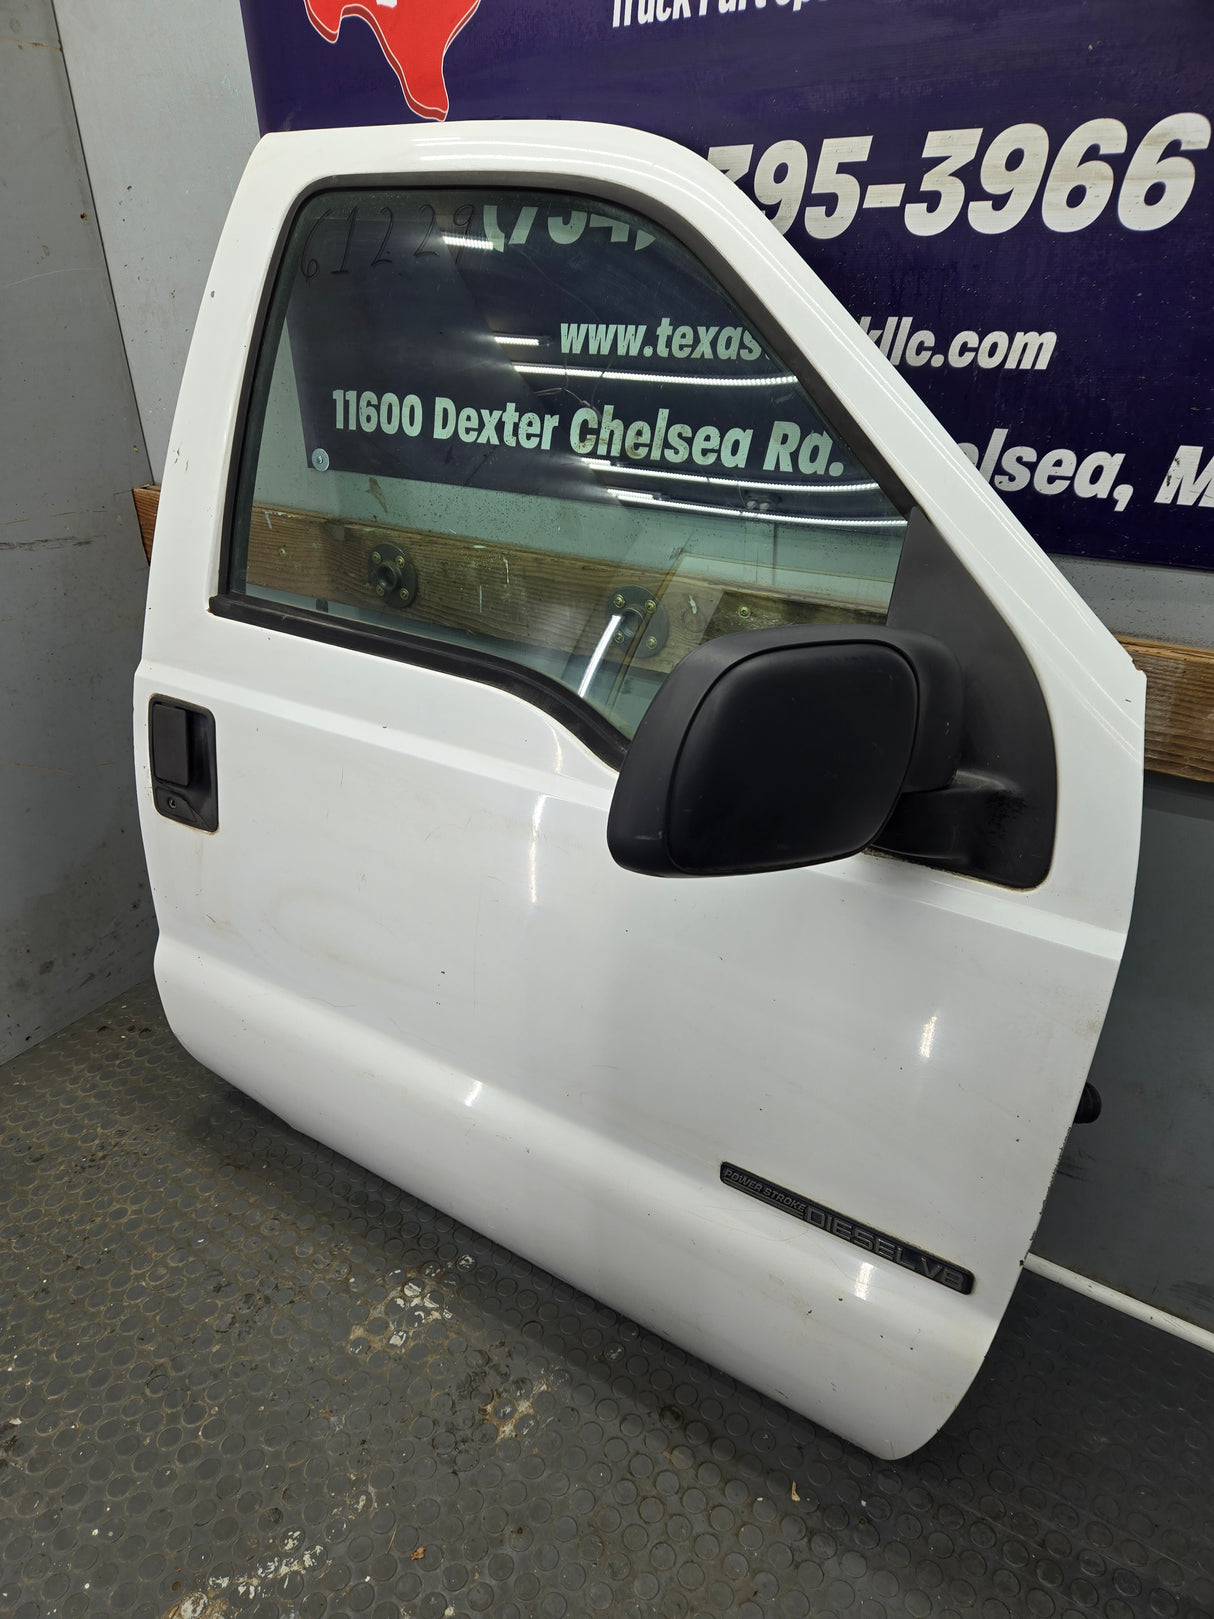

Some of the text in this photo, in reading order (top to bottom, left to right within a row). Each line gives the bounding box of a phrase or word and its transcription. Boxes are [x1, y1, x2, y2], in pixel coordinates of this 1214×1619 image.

[301, 203, 476, 284] 61229
[560, 317, 771, 361] www.texas
[332, 389, 423, 437] 11600
[433, 396, 559, 450] Dexter
[569, 404, 754, 469] Chelsea
[724, 1168, 964, 1291] POWER STROKE DIESEL V8
